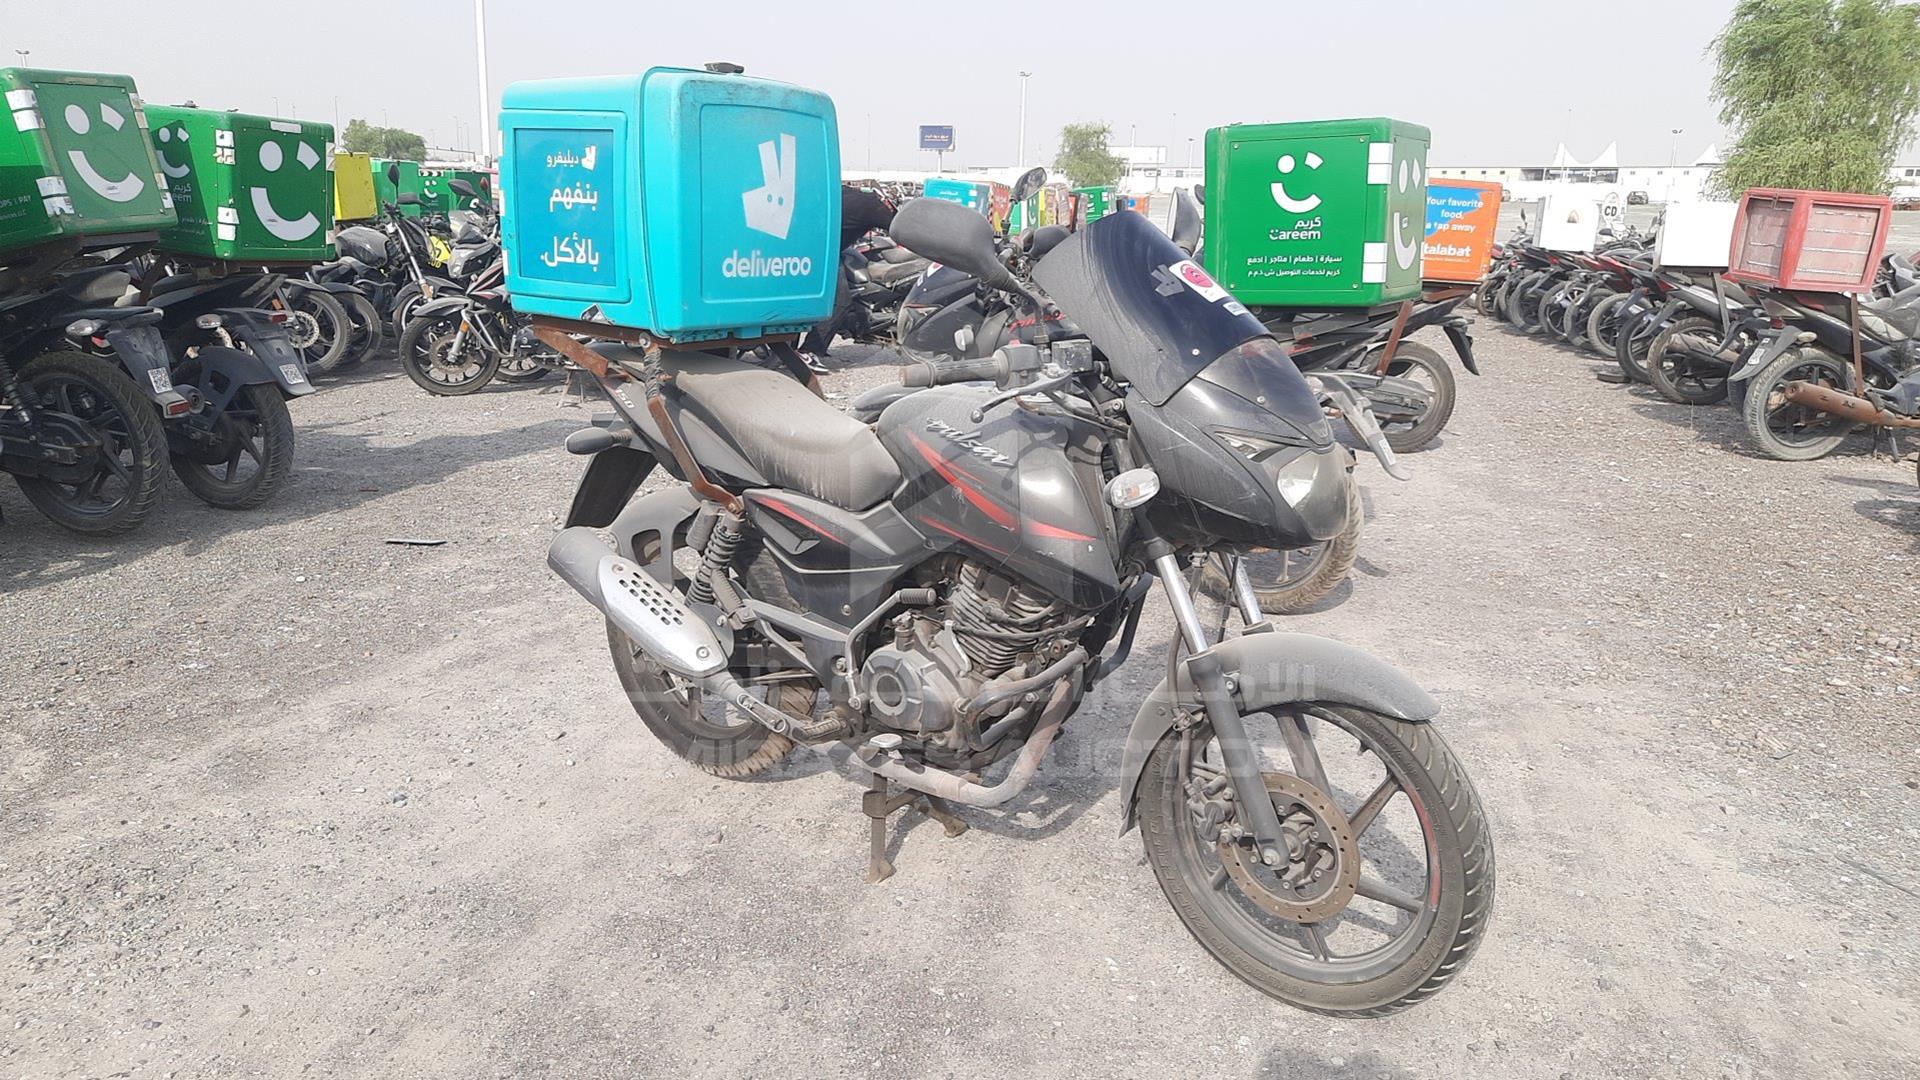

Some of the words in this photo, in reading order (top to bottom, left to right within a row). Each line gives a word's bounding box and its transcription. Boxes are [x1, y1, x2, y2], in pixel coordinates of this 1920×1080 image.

[546, 149, 579, 168] ديليفرو
[549, 181, 598, 212] بنفهم
[1447, 197, 1484, 209] favorite
[1604, 205, 1618, 217] CD
[1294, 216, 1322, 230] كريم
[1451, 223, 1476, 233] away
[1424, 242, 1472, 257] talabat
[722, 249, 812, 278] deliveroo
[1293, 255, 1315, 265] طعام
[1319, 254, 1343, 263] سيارة
[1275, 268, 1301, 277] التوصيل
[1301, 268, 1325, 276] لخدمات
[1325, 269, 1341, 277] كريم
[615, 388, 635, 409] 150
